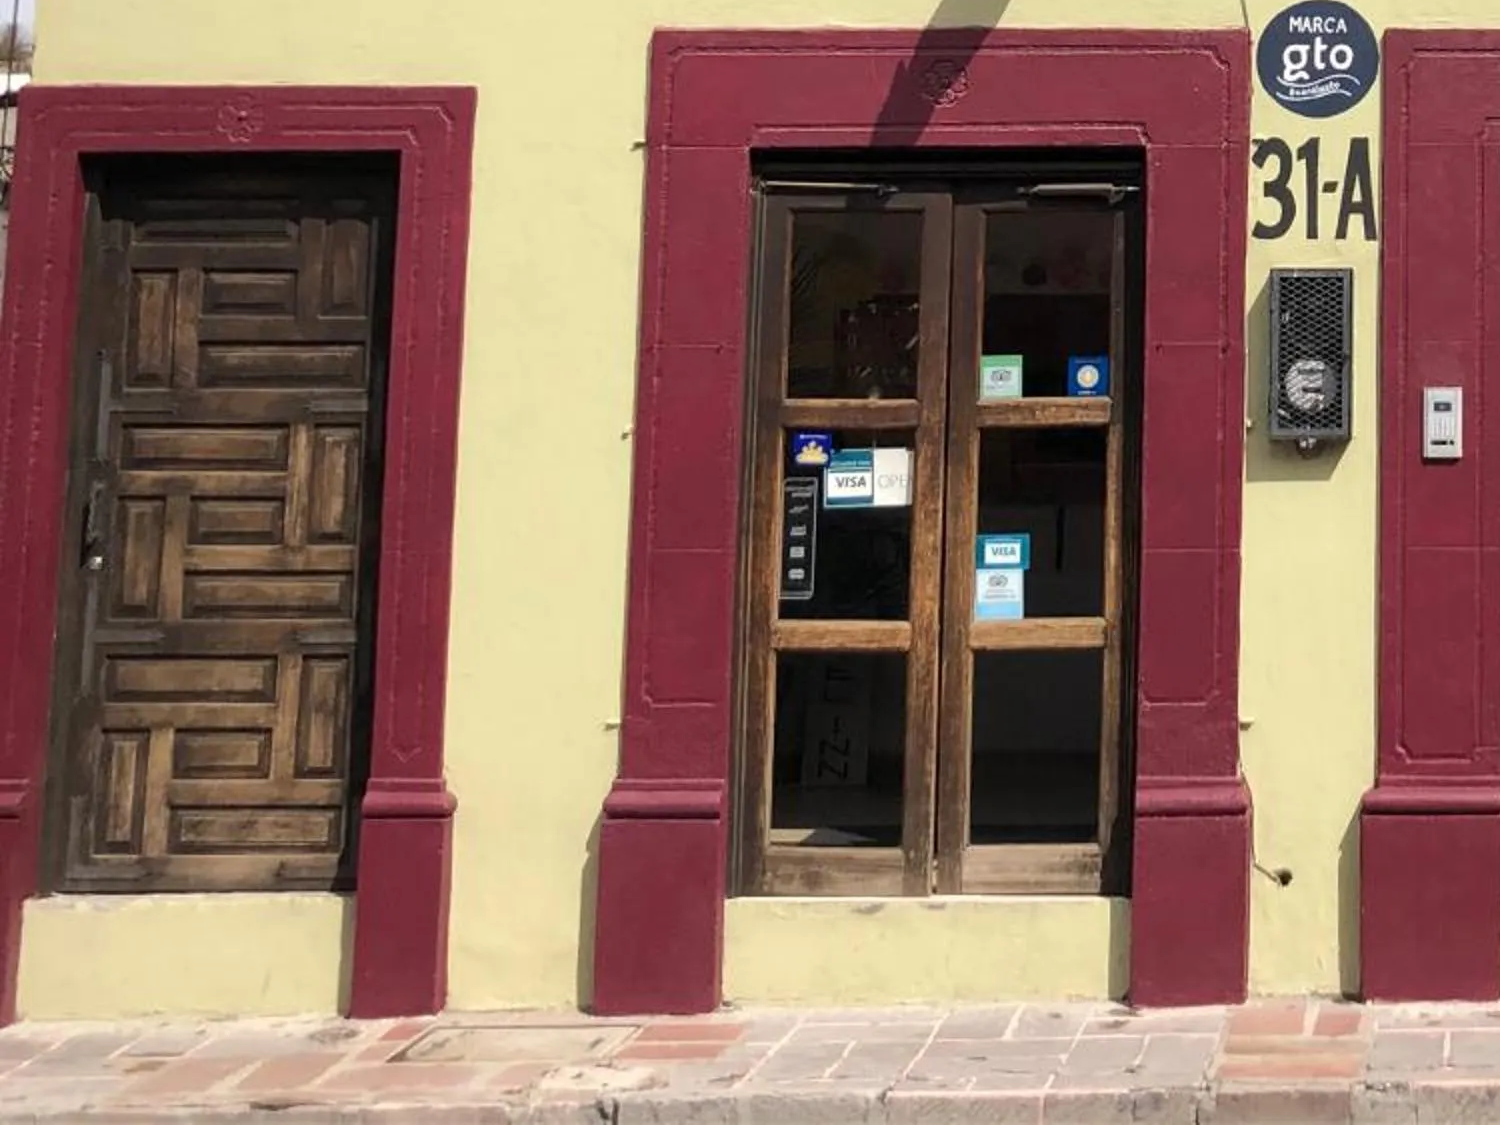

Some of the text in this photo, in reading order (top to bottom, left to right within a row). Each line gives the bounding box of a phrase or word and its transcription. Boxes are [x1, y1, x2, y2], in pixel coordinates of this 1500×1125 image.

[1289, 15, 1348, 34] MARCA
[1282, 36, 1354, 82] gto
[1251, 137, 1377, 241] 31-A
[834, 476, 867, 488] VISA
[991, 546, 1017, 556] VISA
